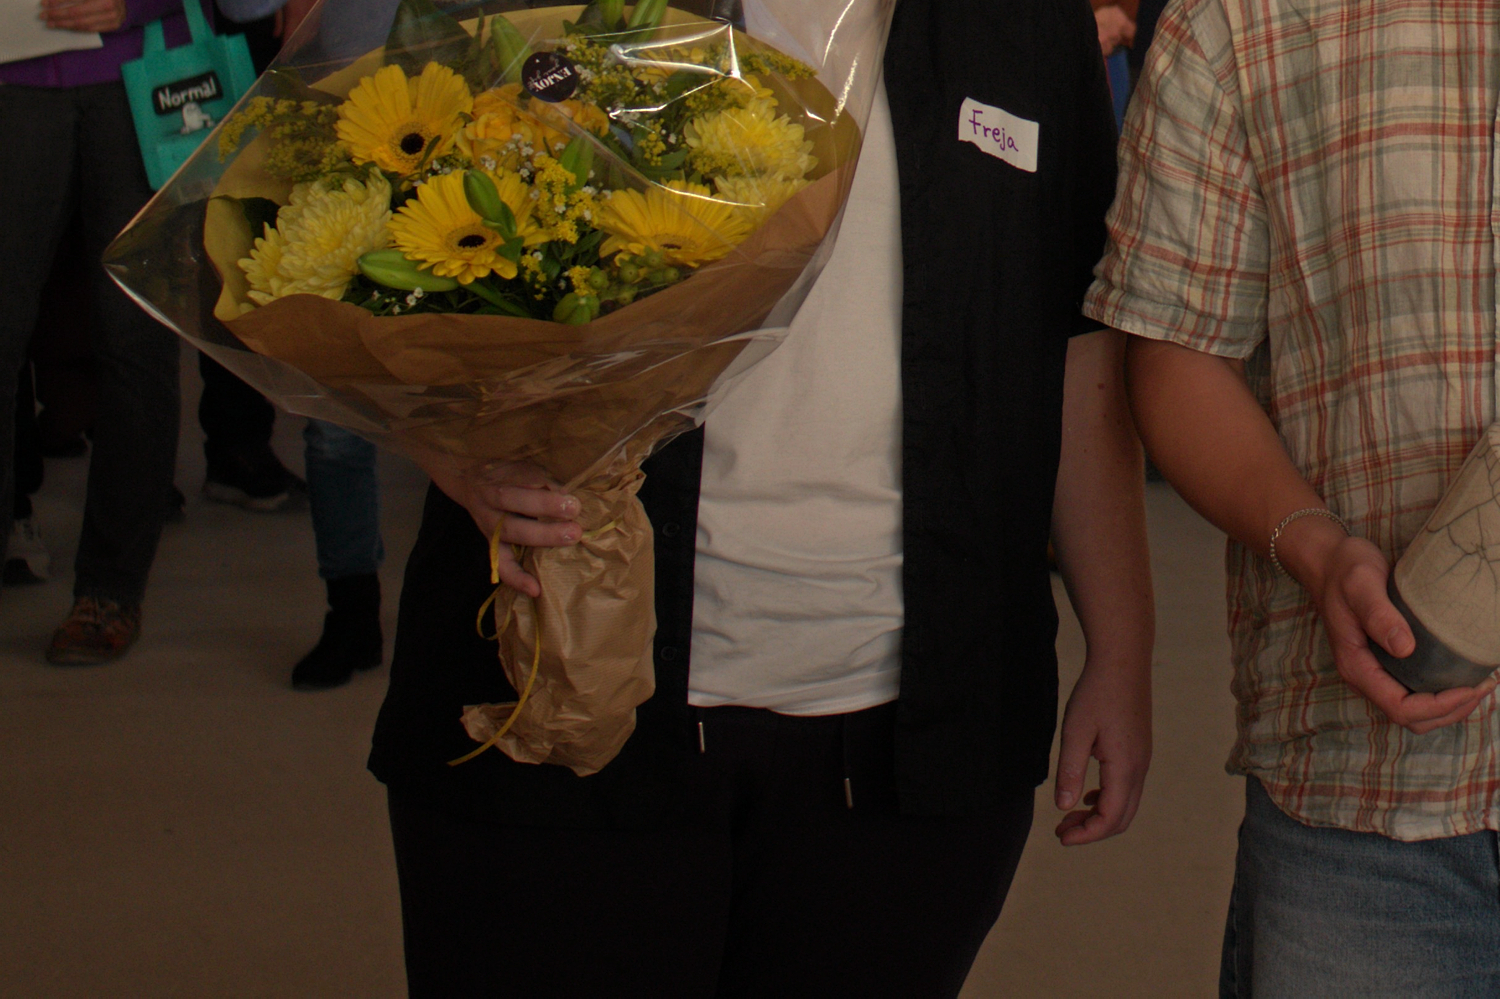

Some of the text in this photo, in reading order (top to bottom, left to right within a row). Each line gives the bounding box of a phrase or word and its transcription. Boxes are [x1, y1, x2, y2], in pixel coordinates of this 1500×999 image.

[157, 75, 217, 110] Normal
[533, 66, 571, 92] ENJOY
[968, 108, 1019, 152] Freja
